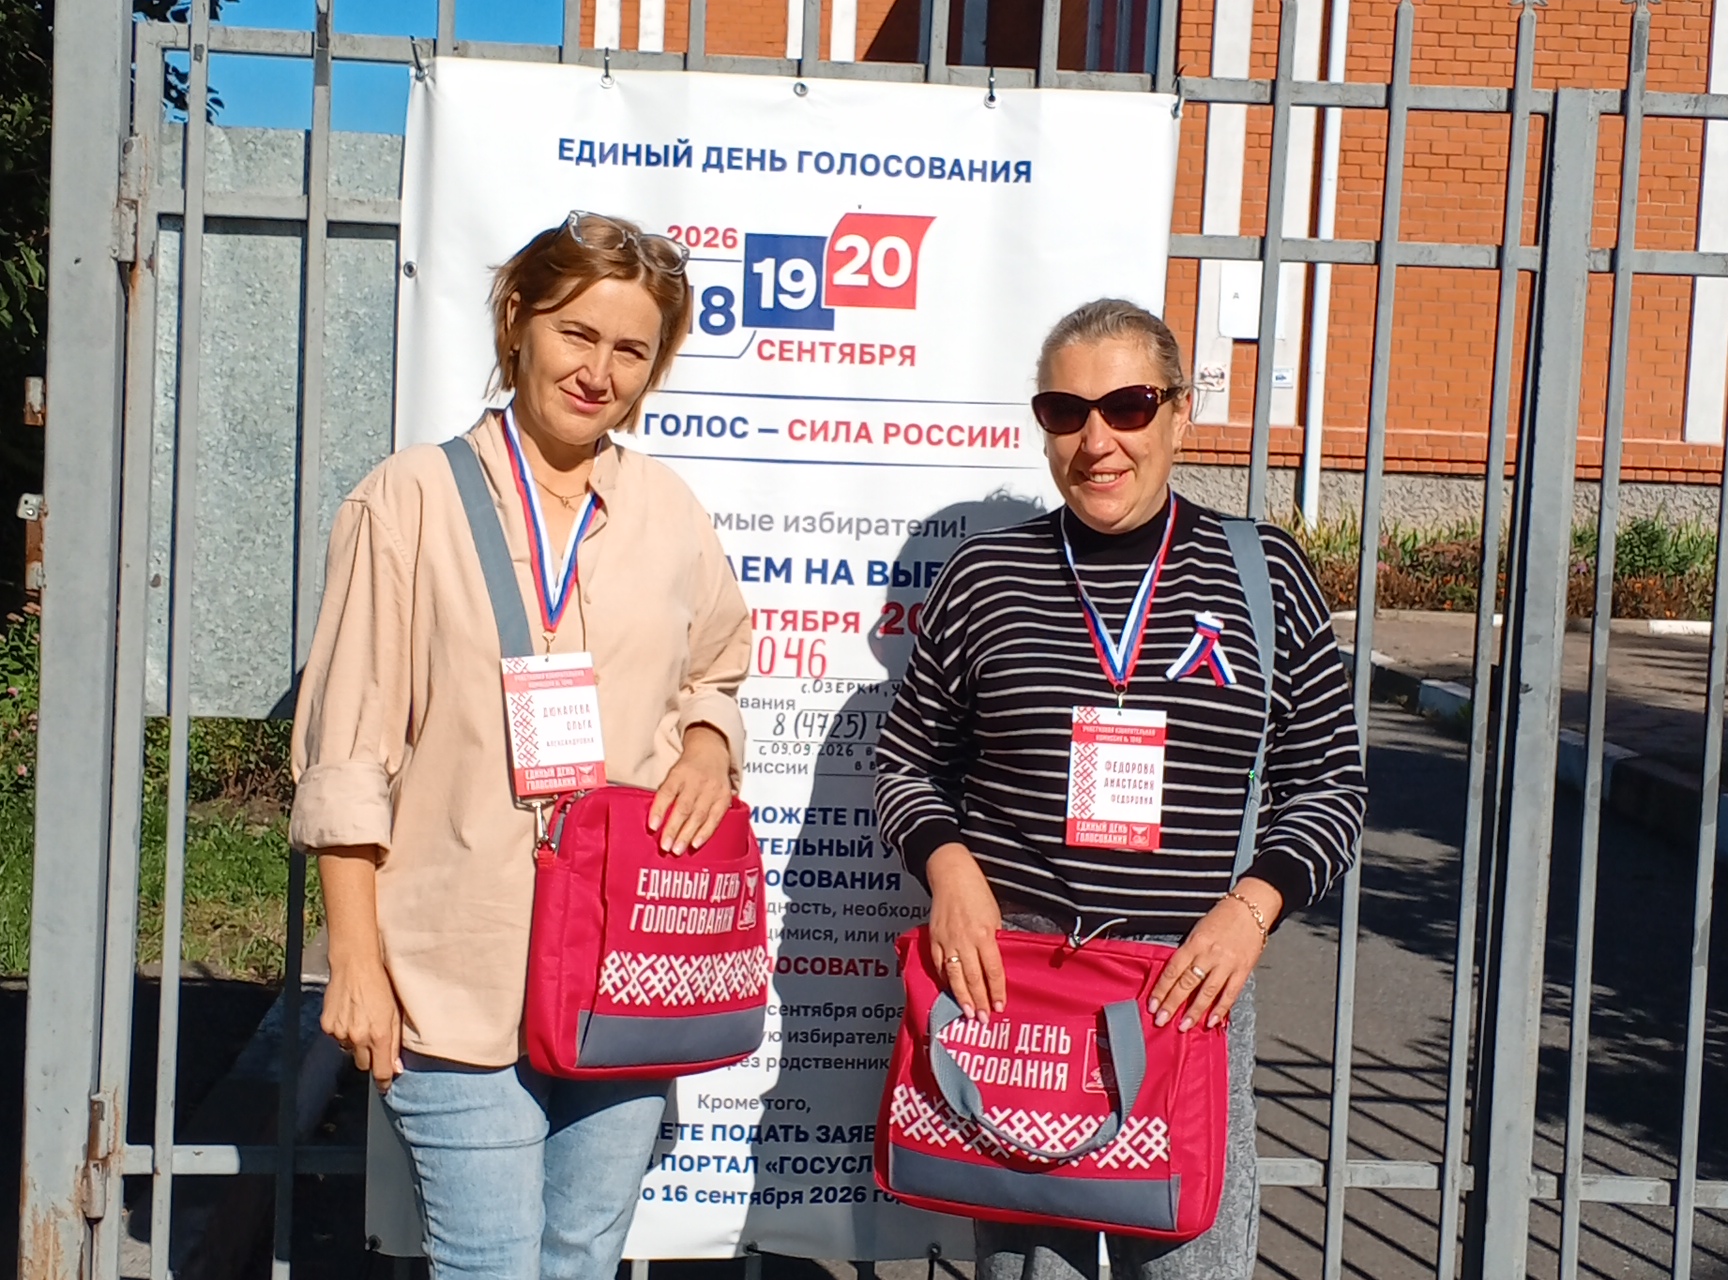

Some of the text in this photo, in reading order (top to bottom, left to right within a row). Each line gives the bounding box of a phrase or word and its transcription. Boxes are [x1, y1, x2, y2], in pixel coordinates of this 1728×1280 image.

[557, 137, 1032, 183] ЕДИНЫЙ ДЕНЬ ГОЛОСОВАНИЯ
[666, 224, 738, 249] 2026
[752, 257, 817, 311] 19
[832, 233, 913, 289] 20
[757, 338, 917, 367] СЕНТЯБРЯ
[643, 412, 750, 439] ГОЛОС
[787, 418, 874, 445] СИЛА
[882, 422, 1021, 450] РОССИИ!
[708, 510, 968, 542] мые избиратели!
[804, 558, 856, 586] НА
[737, 697, 797, 711] вания
[772, 712, 786, 737] 8
[757, 834, 874, 859] ТЕЛЬНЫЙ
[635, 867, 741, 904] ЕДИНЫЙ ДЕНЬ
[765, 868, 901, 891] ОСОВАНИЯ
[629, 903, 736, 936] ГОЛОСОВАНИЯ
[767, 901, 931, 920] дность, необходи
[844, 929, 879, 943] или
[767, 1002, 906, 1022] сентября обра
[787, 1028, 896, 1048] избиратель
[935, 1017, 1072, 1056] ДИНЫЙ ДЕНЬ
[766, 1056, 890, 1072] родственник
[946, 1048, 1069, 1092] ОСОВАНИЯ
[697, 1093, 812, 1114] Кроме того,
[657, 1122, 877, 1145] ЕТЕ ПОДАТЬ ЗАЯВ
[660, 1153, 759, 1174] ПОРТАЛ
[765, 1154, 873, 1175] «ГОСУСЛ
[661, 1184, 689, 1202] 16
[695, 1186, 804, 1210] сентября
[809, 1185, 868, 1205] 2026
